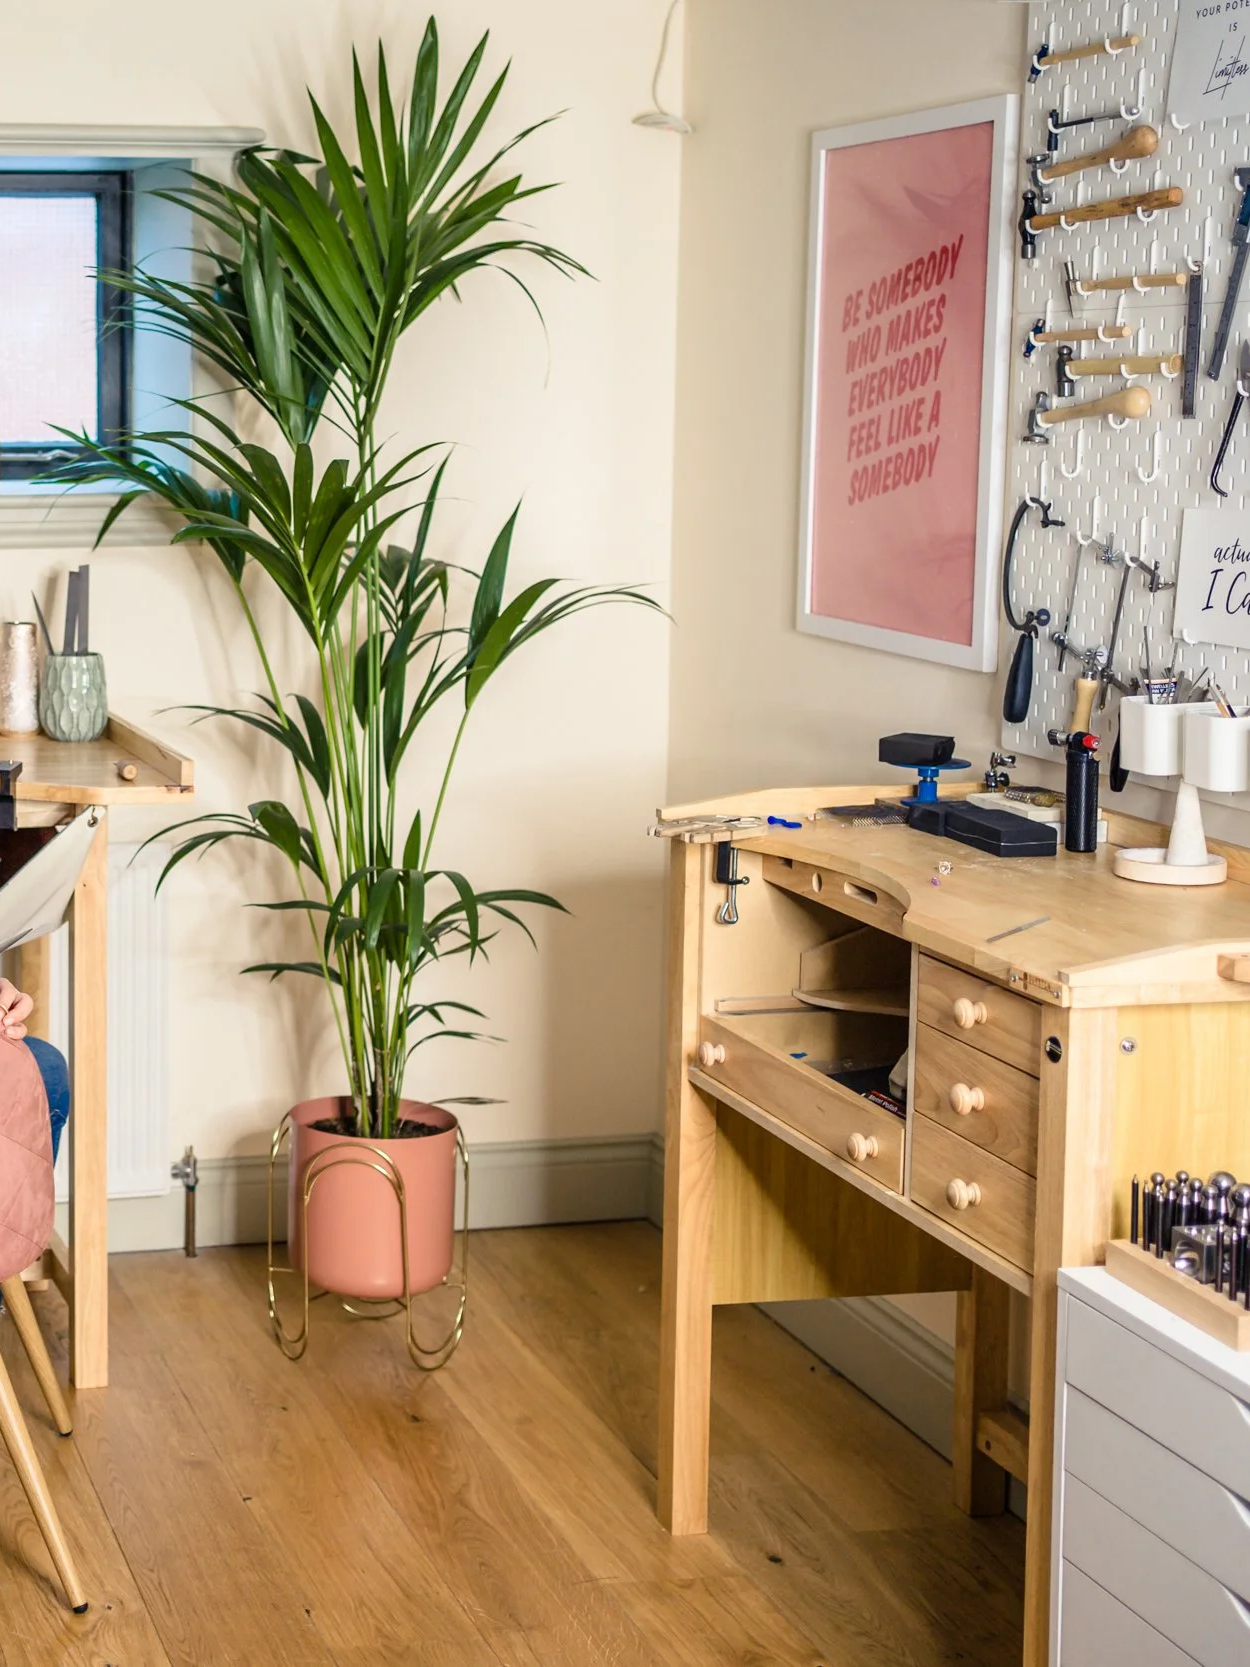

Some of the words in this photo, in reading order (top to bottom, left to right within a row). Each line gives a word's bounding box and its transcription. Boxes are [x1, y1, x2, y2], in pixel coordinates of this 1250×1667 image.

[1196, 5, 1222, 19] YOUR
[1229, 22, 1238, 32] IS
[842, 289, 864, 332] BE
[865, 233, 964, 320] SOMEBODY
[846, 324, 881, 374] WHO
[885, 293, 947, 356] MAKES
[848, 337, 947, 417] EVERYBODY
[847, 414, 882, 463] FEEL
[887, 397, 925, 447] LIKE
[928, 390, 941, 432] A
[848, 435, 940, 506] SOMEBODY
[1202, 568, 1224, 611] I
